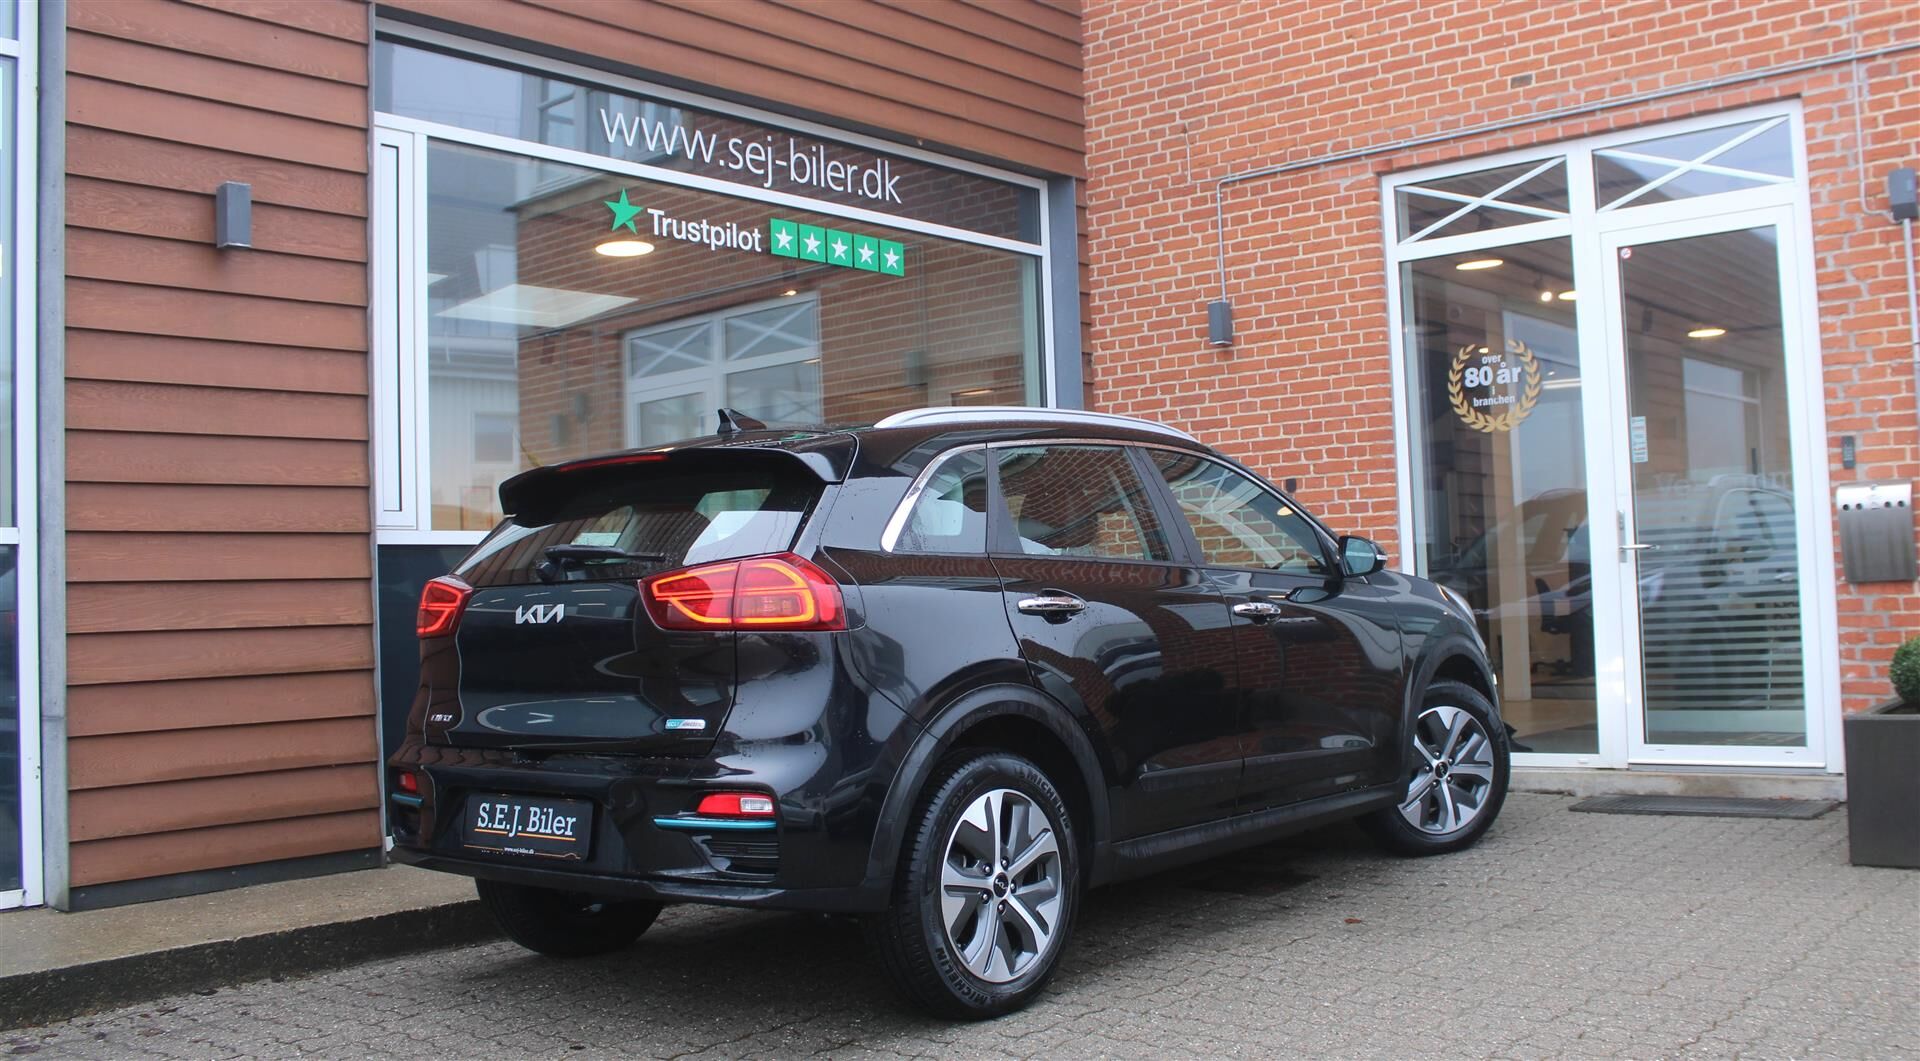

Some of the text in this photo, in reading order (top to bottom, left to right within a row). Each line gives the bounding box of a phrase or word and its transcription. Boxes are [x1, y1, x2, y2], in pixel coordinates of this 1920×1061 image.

[600, 108, 902, 203] www.sej-biler.dk
[647, 208, 761, 252] Trustpilot
[1482, 354, 1502, 364] over
[1464, 362, 1521, 388] 80 år
[1473, 395, 1515, 407] branchen
[477, 802, 576, 837] S.E.J. Biler
